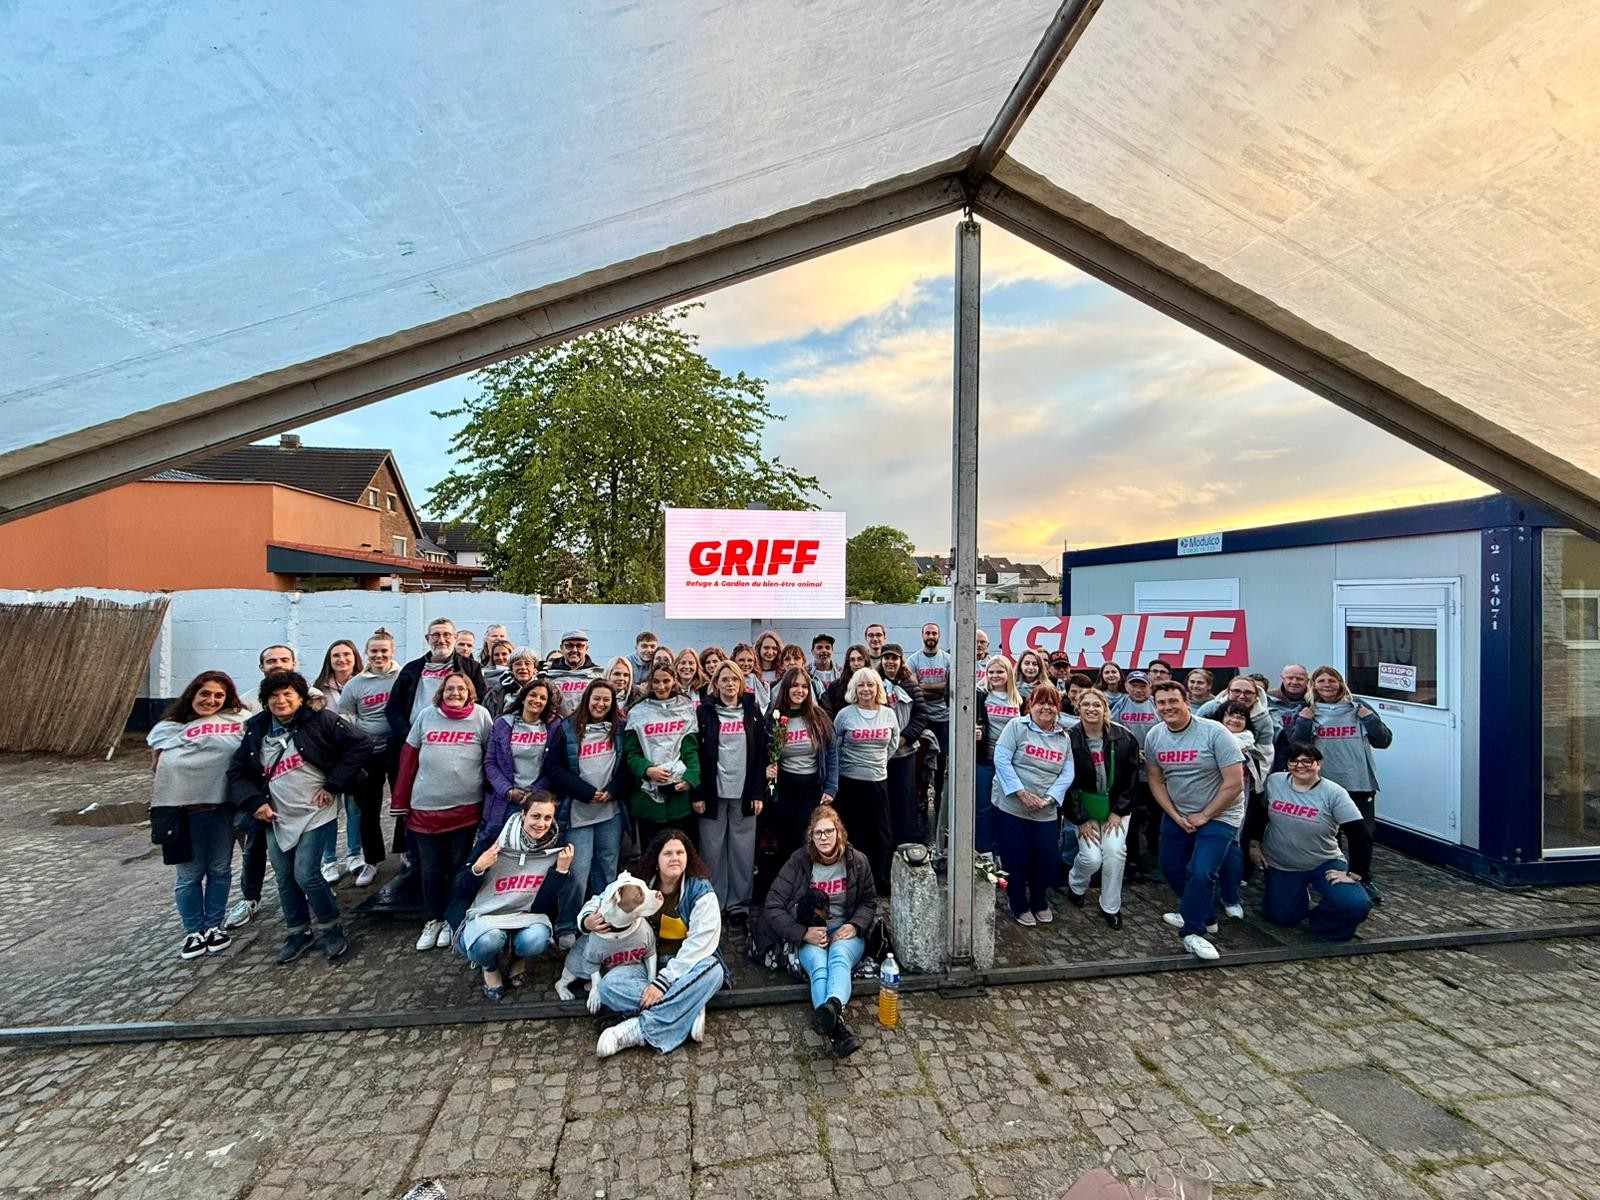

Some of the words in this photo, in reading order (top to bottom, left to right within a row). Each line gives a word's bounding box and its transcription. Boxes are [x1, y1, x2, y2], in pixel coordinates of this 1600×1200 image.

[689, 539, 820, 576] GRIFF
[686, 580, 712, 588] Refuge
[1009, 615, 1236, 669] GRIFF
[919, 668, 945, 677] GRIFF
[1387, 666, 1407, 675] STOP
[363, 692, 389, 707] GRI
[986, 706, 1019, 716] GRIFF
[1121, 713, 1155, 721] GRIFF
[186, 723, 241, 738] GRIFF
[643, 720, 686, 736] GRIFF
[719, 721, 745, 733] RIF
[1317, 726, 1356, 738] GRIFF
[426, 730, 475, 745] GRIFF
[787, 730, 811, 742] RIF
[851, 728, 889, 741] GRIFF
[579, 740, 614, 757] RIFF
[1025, 744, 1064, 762] GRIFF
[1157, 750, 1198, 762] GRIFF
[1271, 800, 1319, 818] GRIFF
[495, 875, 544, 892] GRIFF
